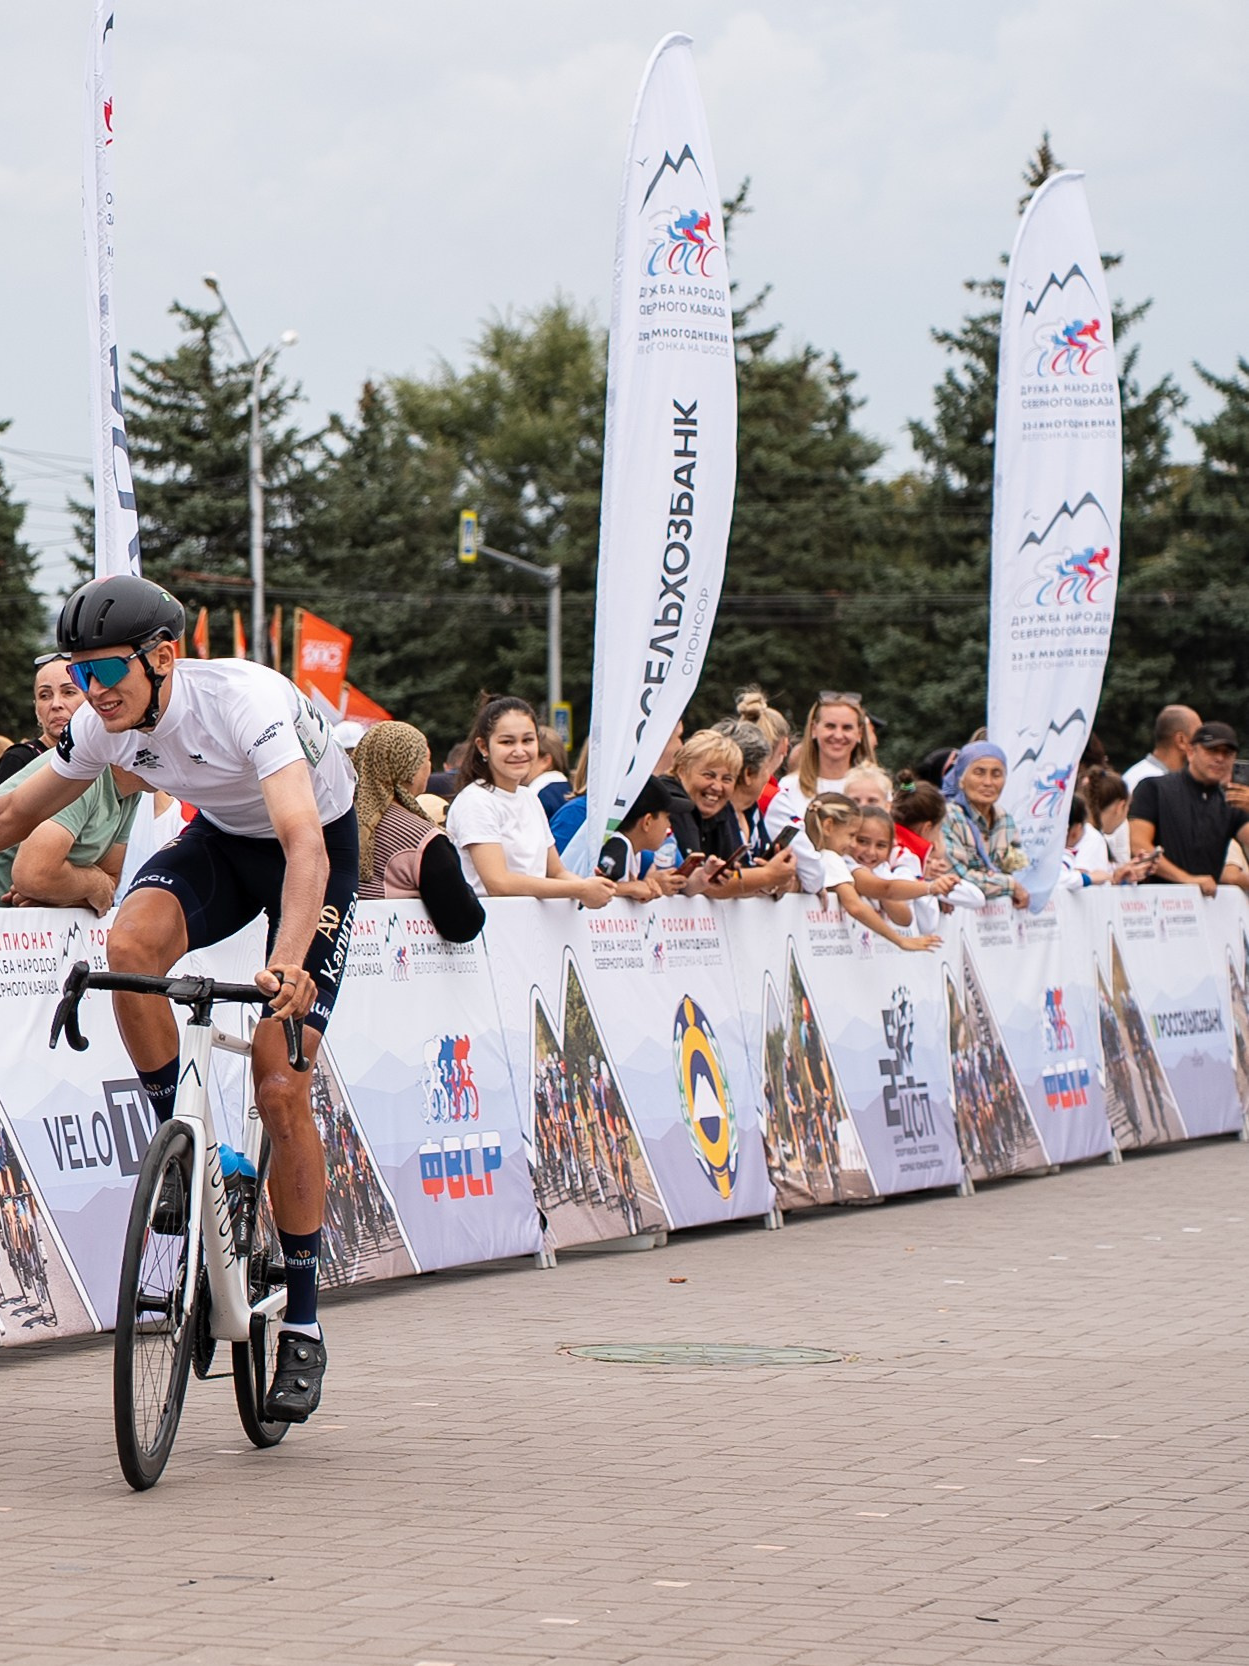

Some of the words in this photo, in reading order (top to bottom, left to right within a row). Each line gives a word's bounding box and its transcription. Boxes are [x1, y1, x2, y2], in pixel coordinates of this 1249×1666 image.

[681, 587, 710, 677] СПОНСОР
[16, 957, 57, 975] НАРОДОВ
[93, 956, 107, 970] 33-
[29, 980, 61, 995] КАВКАЗА
[419, 1130, 502, 1203] ФВСР
